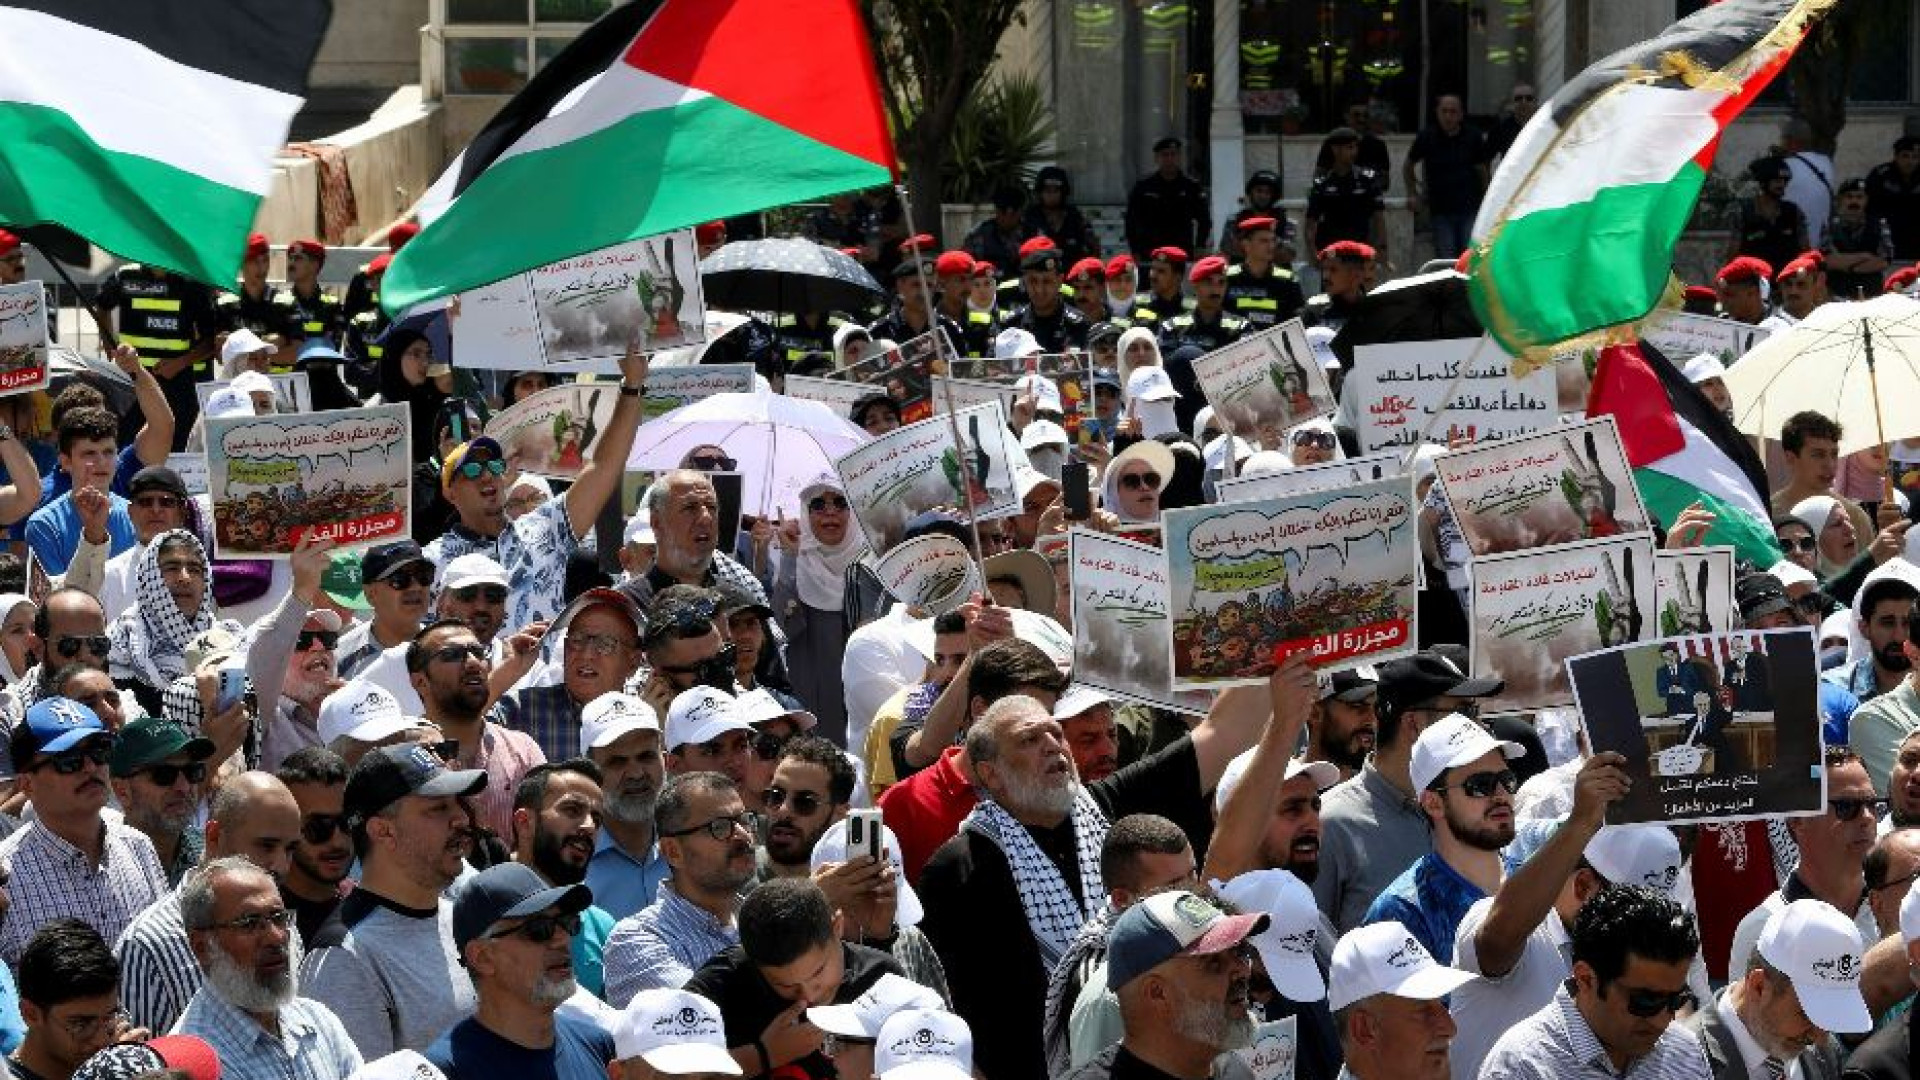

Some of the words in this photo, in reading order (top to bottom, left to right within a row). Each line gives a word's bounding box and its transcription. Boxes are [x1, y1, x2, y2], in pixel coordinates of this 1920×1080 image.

[147, 316, 178, 330] POLICE
[301, 524, 344, 543] الفج
[347, 517, 396, 538] مجزرة
[1526, 573, 1550, 588] قادة
[1553, 566, 1597, 586] اغتيالات
[1343, 626, 1399, 653] مجزرة
[1705, 801, 1721, 814] من
